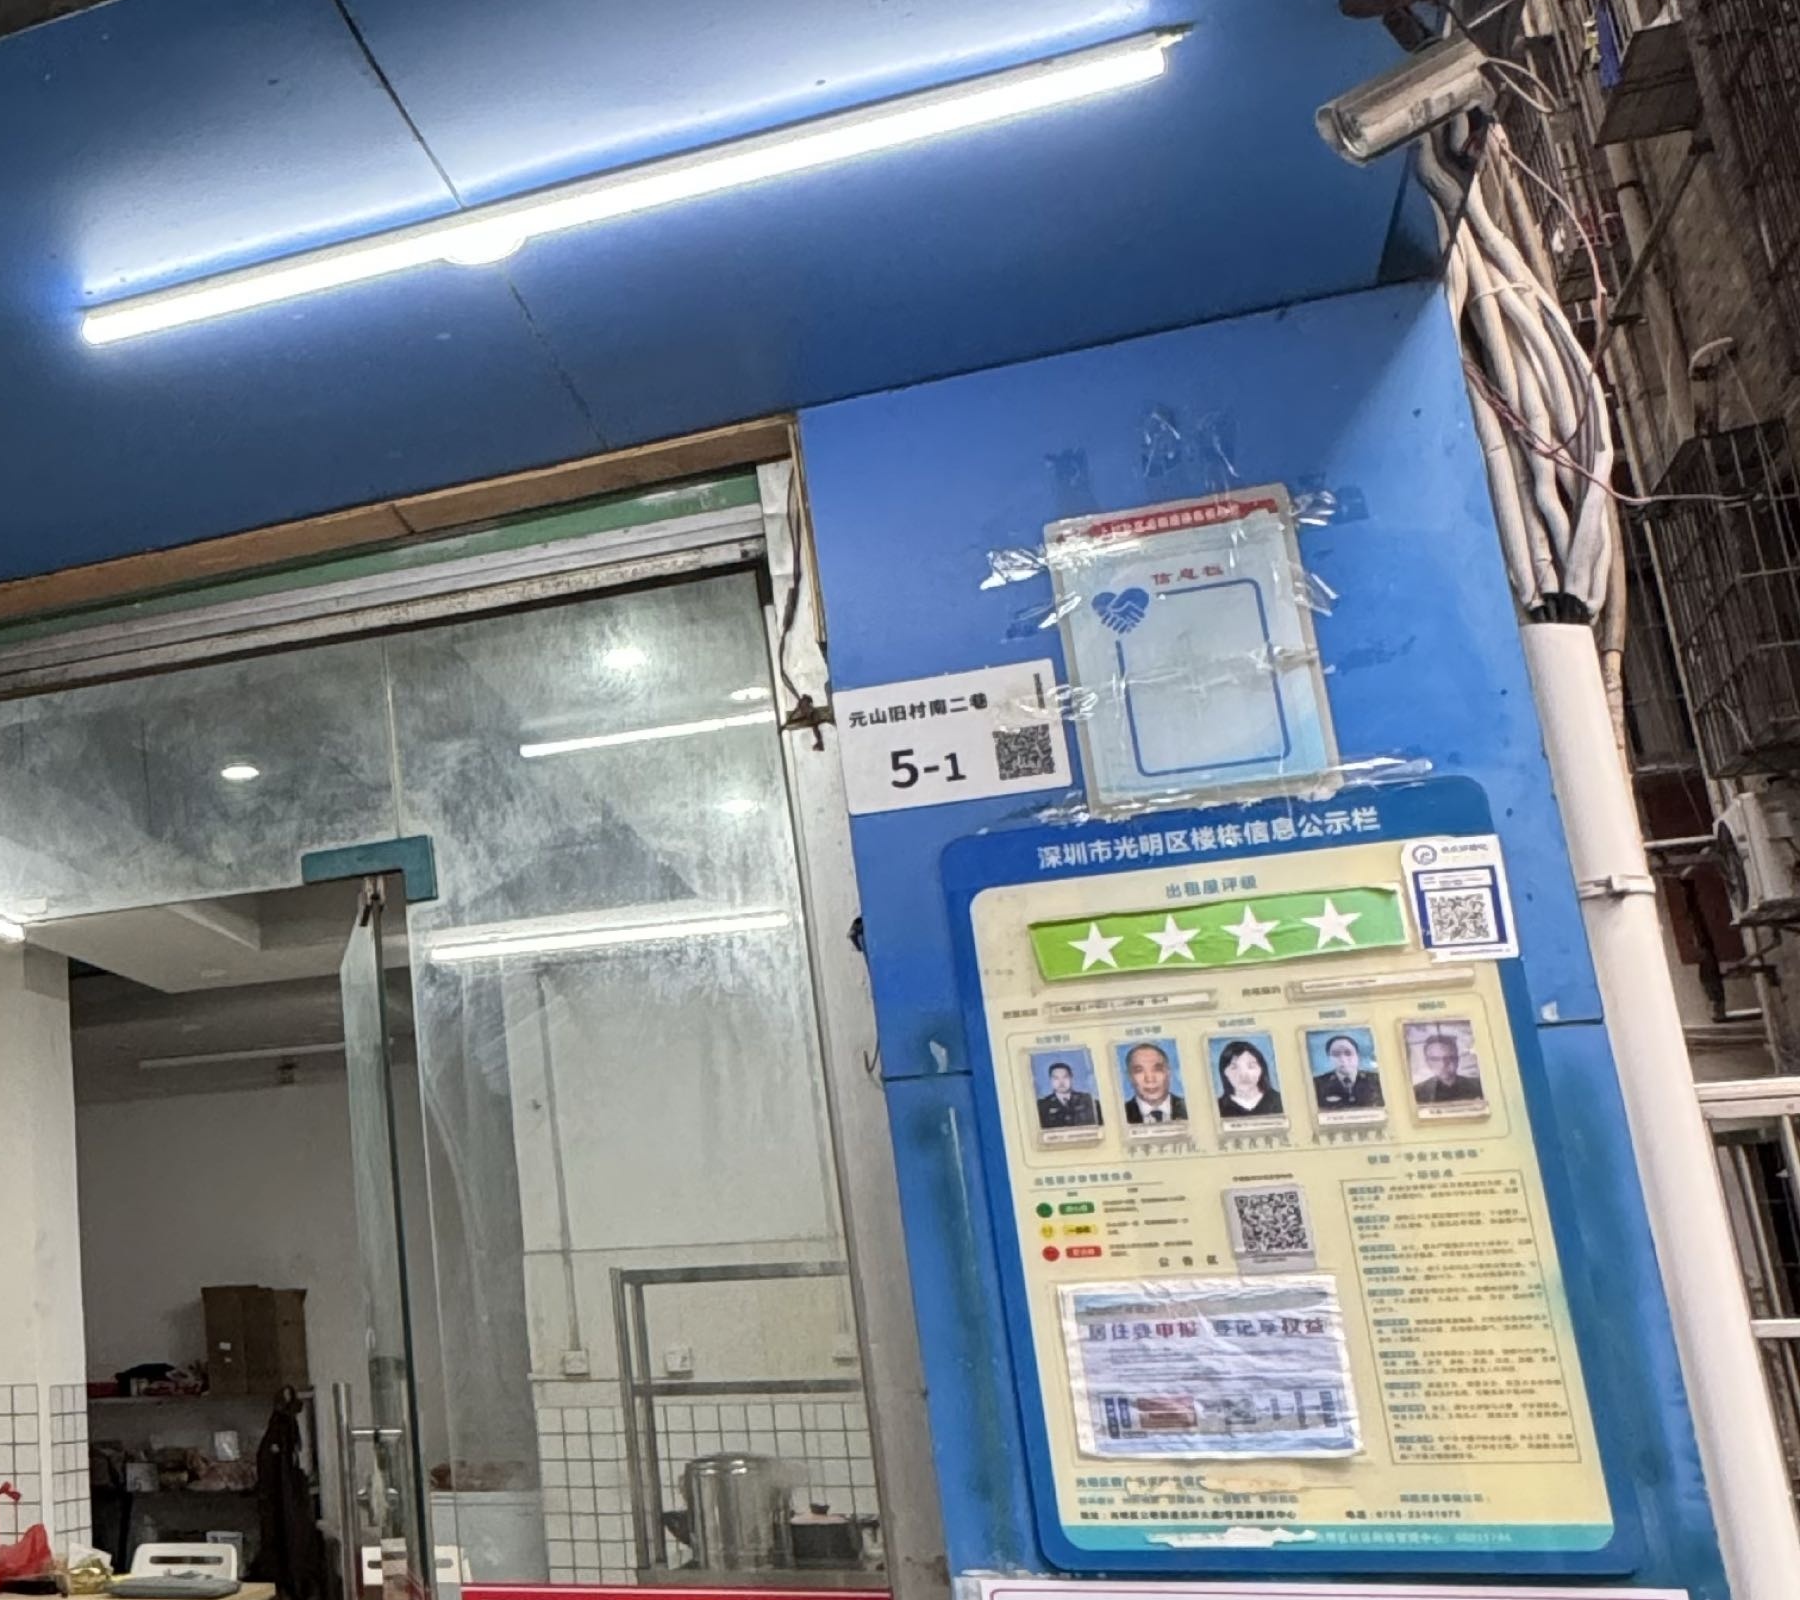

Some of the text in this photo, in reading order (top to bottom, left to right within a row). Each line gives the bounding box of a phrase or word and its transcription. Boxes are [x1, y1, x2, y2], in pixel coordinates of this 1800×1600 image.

[890, 749, 967, 790] 5-1
[1037, 806, 1381, 870] 深圳市光明区楼栋信息公示栏
